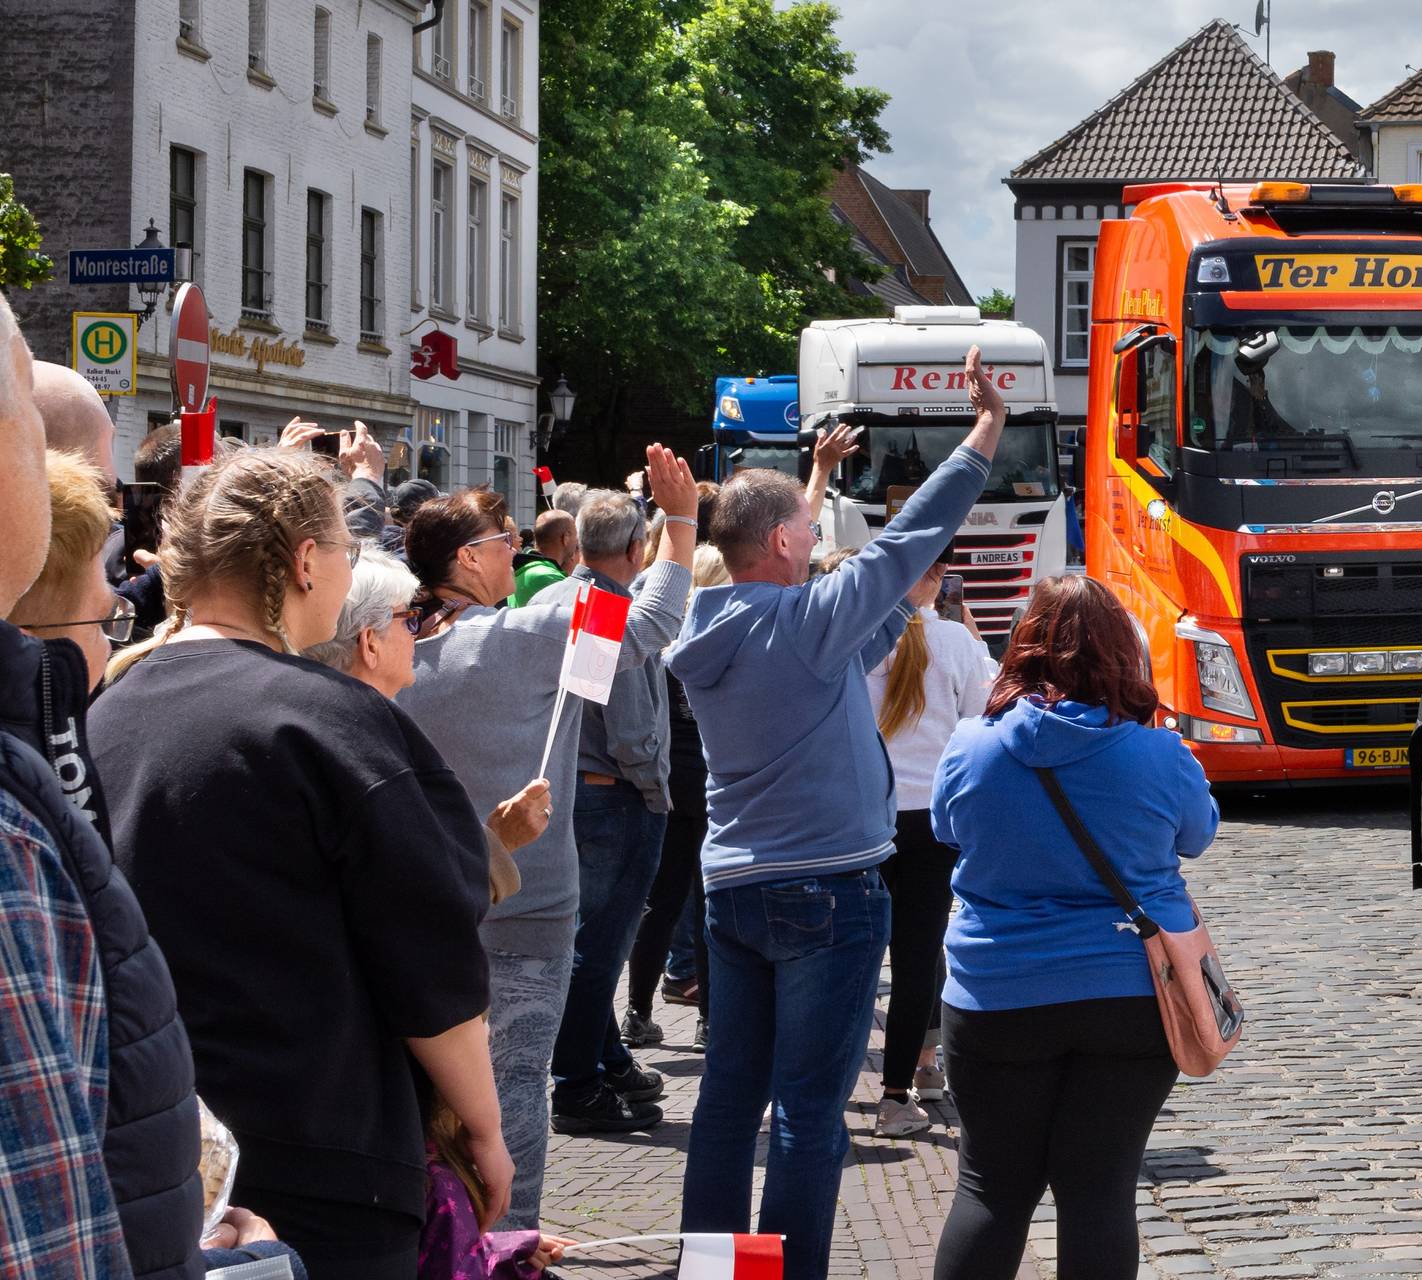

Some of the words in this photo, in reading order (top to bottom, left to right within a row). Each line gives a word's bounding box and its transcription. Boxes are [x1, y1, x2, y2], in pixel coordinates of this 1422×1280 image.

[75, 254, 168, 277] Monrestraße
[1261, 257, 1338, 289] Ter
[95, 330, 114, 355] H
[966, 512, 999, 526] NIA
[976, 552, 1019, 563] ANDREAS
[1248, 555, 1296, 563] VOLVO
